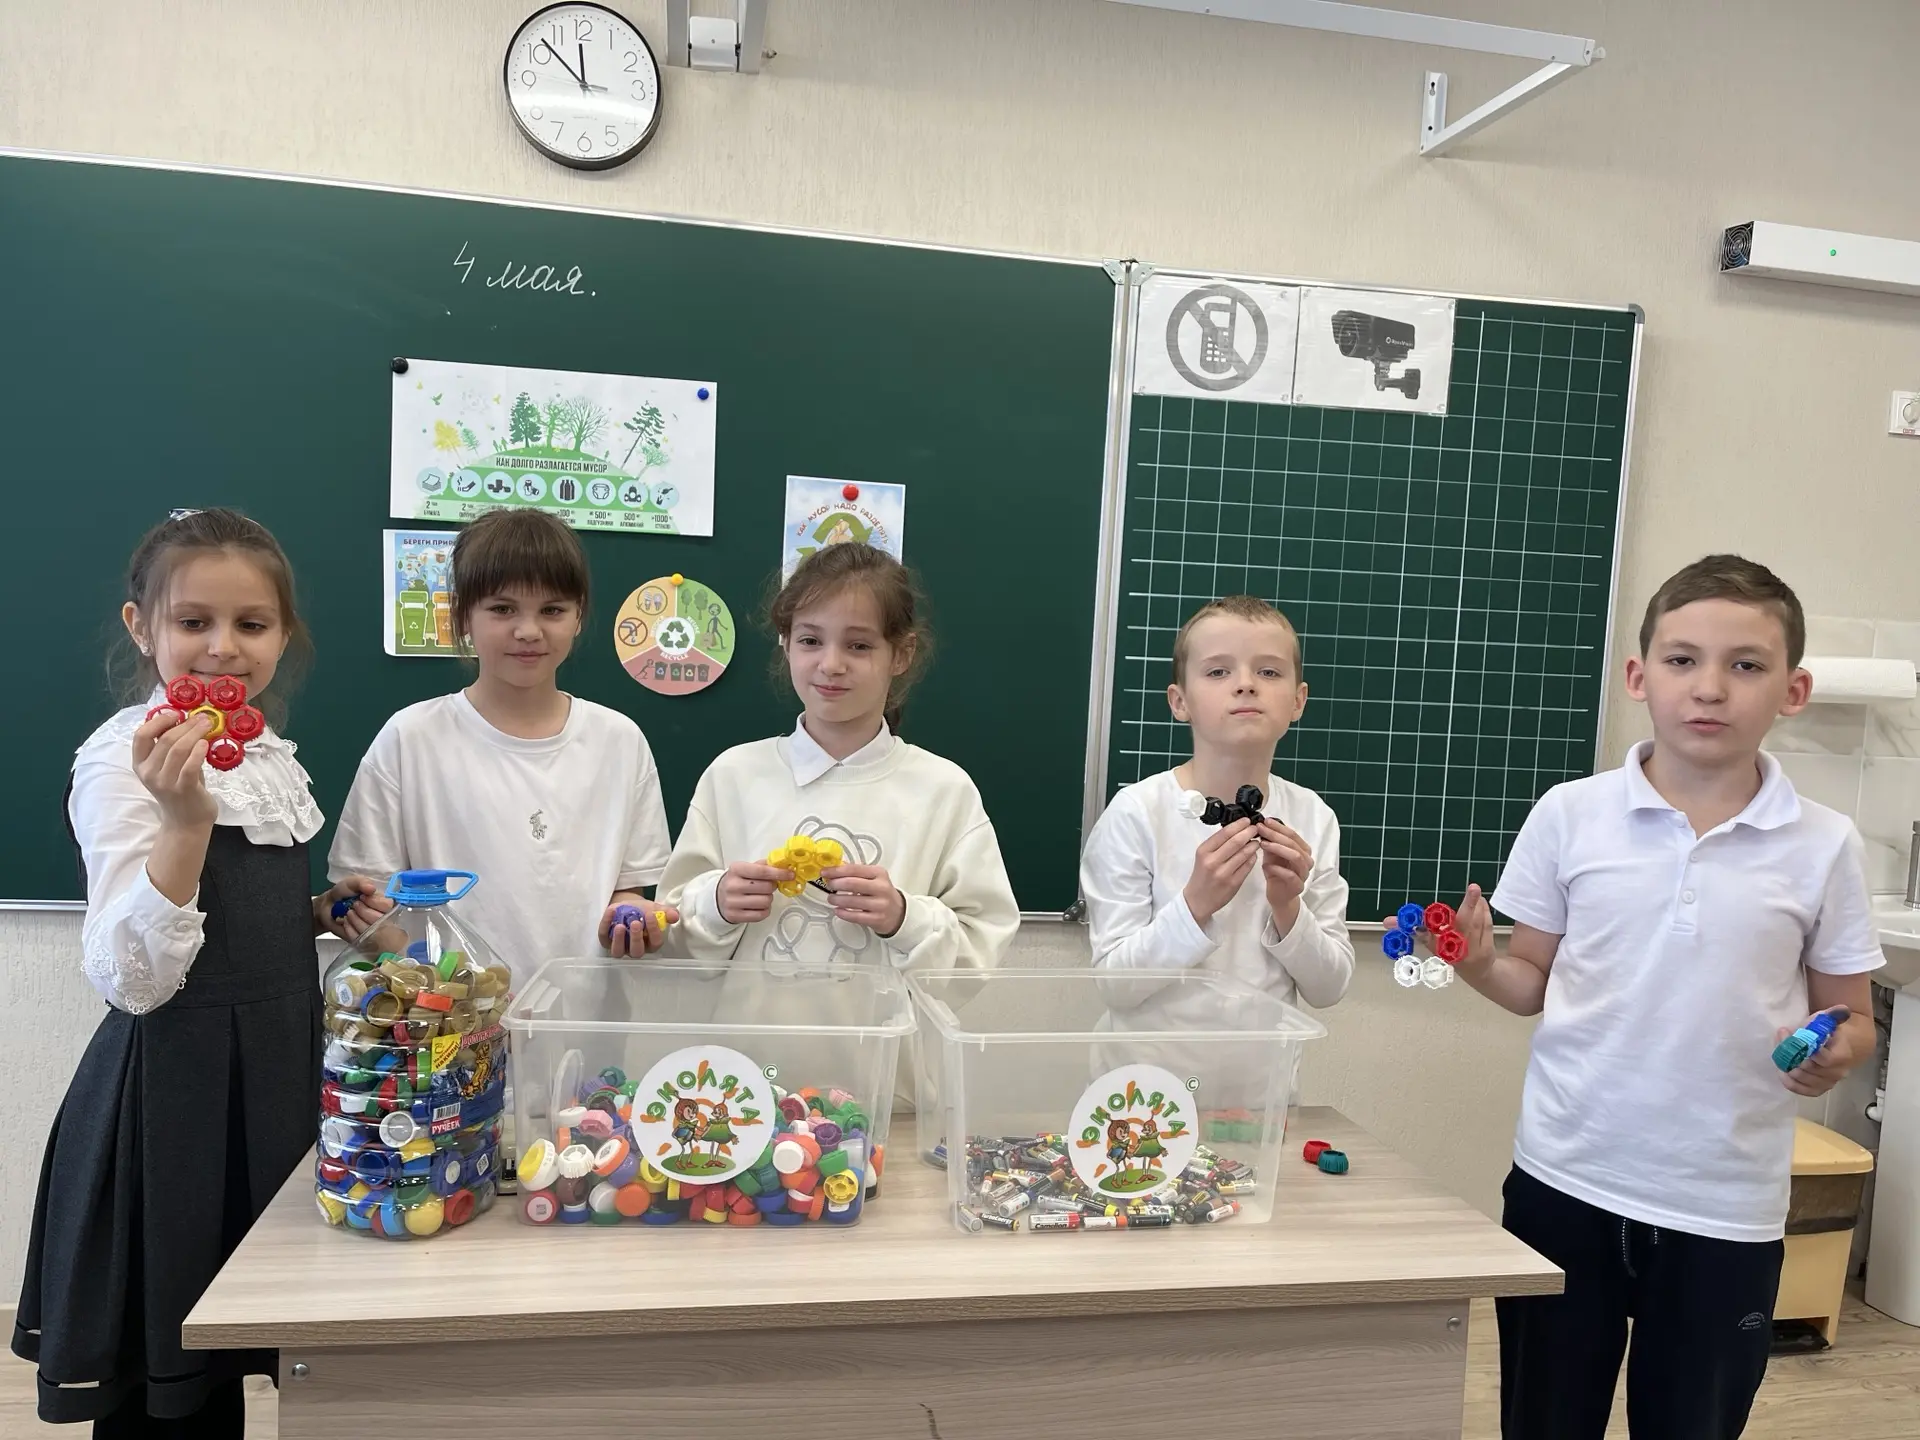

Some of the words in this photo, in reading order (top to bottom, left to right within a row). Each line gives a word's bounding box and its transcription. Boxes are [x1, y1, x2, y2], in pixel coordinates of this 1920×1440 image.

[551, 24, 563, 46] 11
[574, 19, 593, 42] 12
[608, 29, 613, 50] 1
[527, 42, 551, 65] 10
[623, 51, 638, 73] 2
[521, 70, 537, 91] 9
[631, 79, 646, 101] 3
[550, 120, 565, 142] 7
[577, 131, 592, 152] 6
[605, 125, 619, 147] 5
[453, 240, 476, 284] 4
[486, 261, 596, 297] мая.
[496, 457, 510, 468] КАК
[511, 459, 534, 470] ДОЛГО
[534, 460, 582, 473] РАЗЛАГАЕТСЯ
[583, 463, 608, 474] МУСОР
[796, 522, 807, 537] КАК
[807, 504, 831, 523] МУСОР
[834, 502, 858, 512] НАДО
[403, 538, 431, 546] БЕРЕГИ
[432, 1119, 461, 1135] РУЧЕЕК
[1034, 1222, 1068, 1230] Camelion
